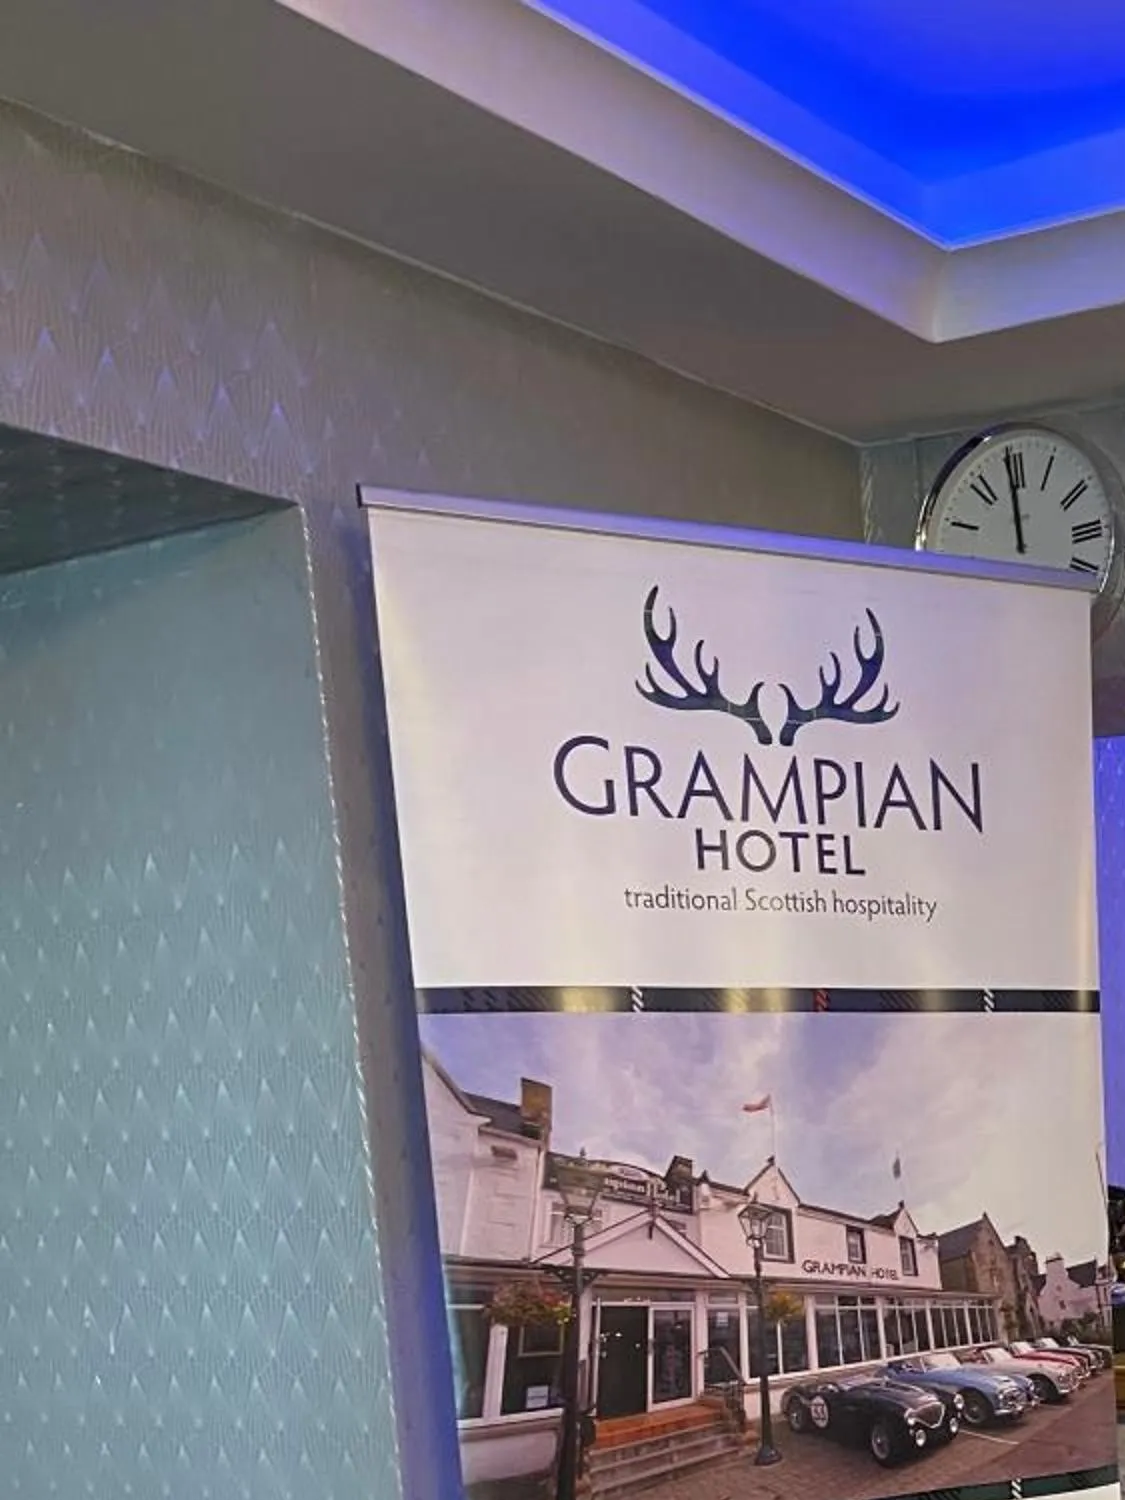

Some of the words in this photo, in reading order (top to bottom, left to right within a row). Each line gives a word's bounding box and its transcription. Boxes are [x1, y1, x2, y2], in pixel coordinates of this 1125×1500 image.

[553, 735, 984, 834] GRAMPIAN
[695, 828, 866, 875] HOTEL
[623, 885, 739, 912] traditional
[744, 888, 828, 915] Scottish
[832, 889, 938, 923] hospitality
[801, 1259, 867, 1277] GRAMPIAN
